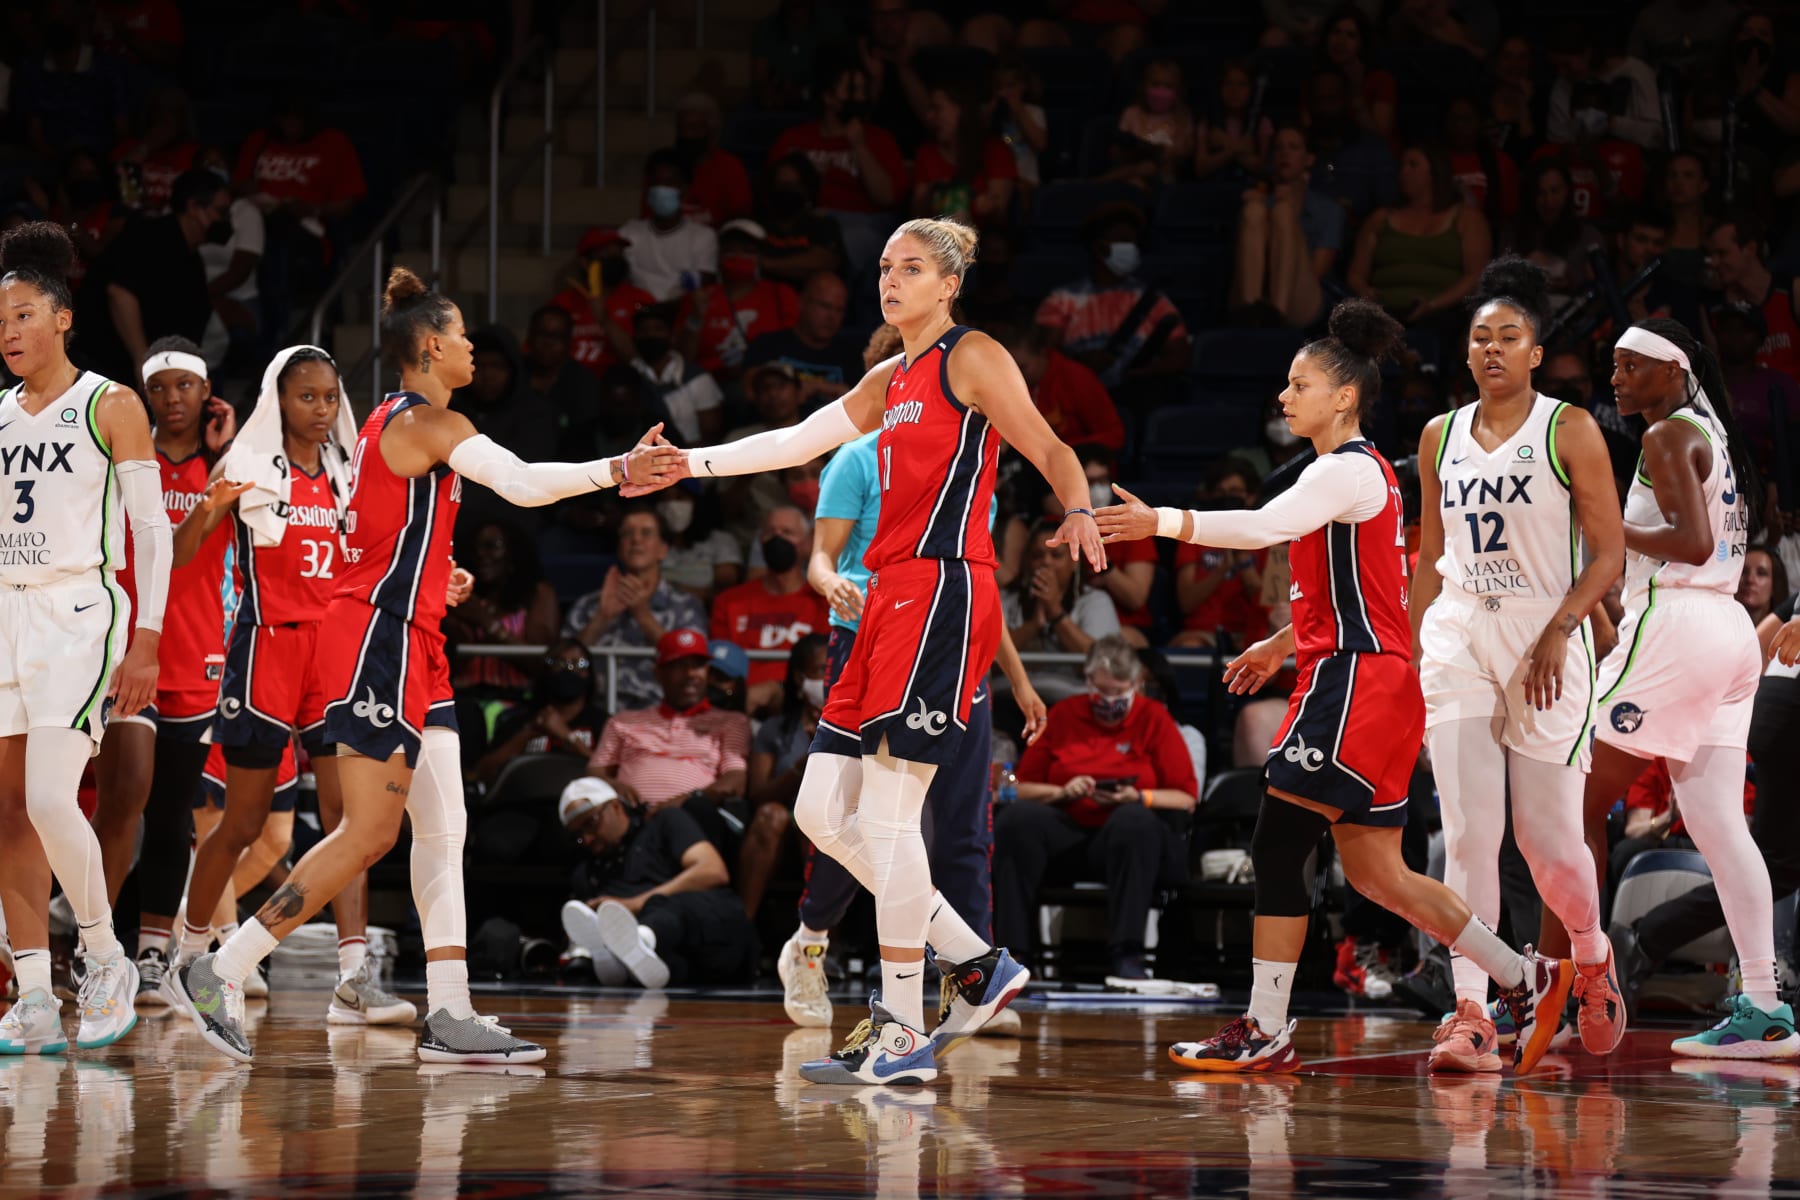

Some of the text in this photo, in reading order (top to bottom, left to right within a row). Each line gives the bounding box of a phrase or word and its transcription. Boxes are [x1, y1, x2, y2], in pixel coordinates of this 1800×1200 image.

[1, 442, 75, 475] YNX
[13, 480, 36, 523] 3
[1444, 475, 1532, 508] LYNX
[288, 505, 338, 533] ashing
[1465, 512, 1508, 553] 12
[0, 532, 46, 548] MAYO
[300, 539, 334, 579] 32
[1464, 558, 1520, 578] MAYO
[1462, 574, 1529, 594] CLINIC
